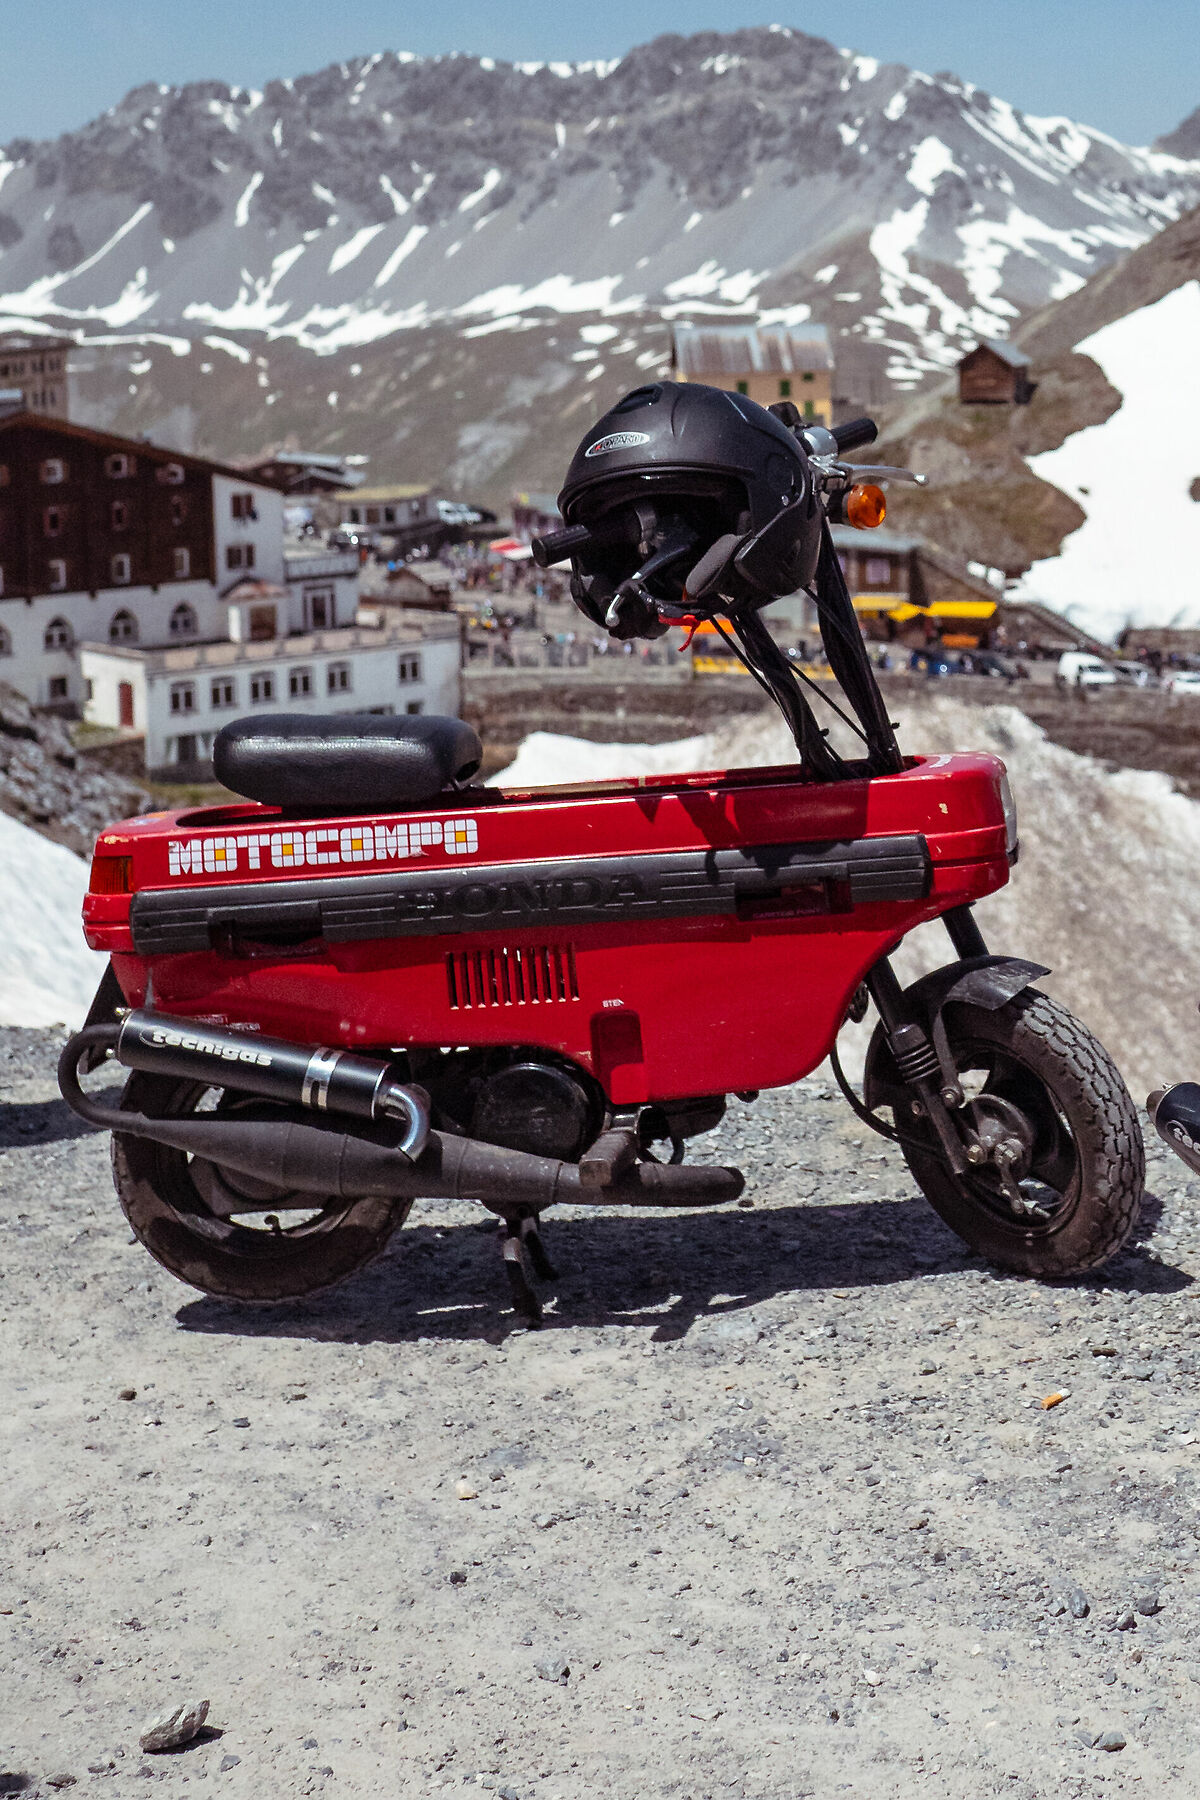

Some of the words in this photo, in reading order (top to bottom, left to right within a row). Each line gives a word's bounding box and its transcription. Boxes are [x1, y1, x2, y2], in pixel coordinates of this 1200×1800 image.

[168, 818, 479, 877] MOTOCOMPO
[397, 872, 658, 923] HONDA
[152, 1029, 273, 1066] tecnigas
